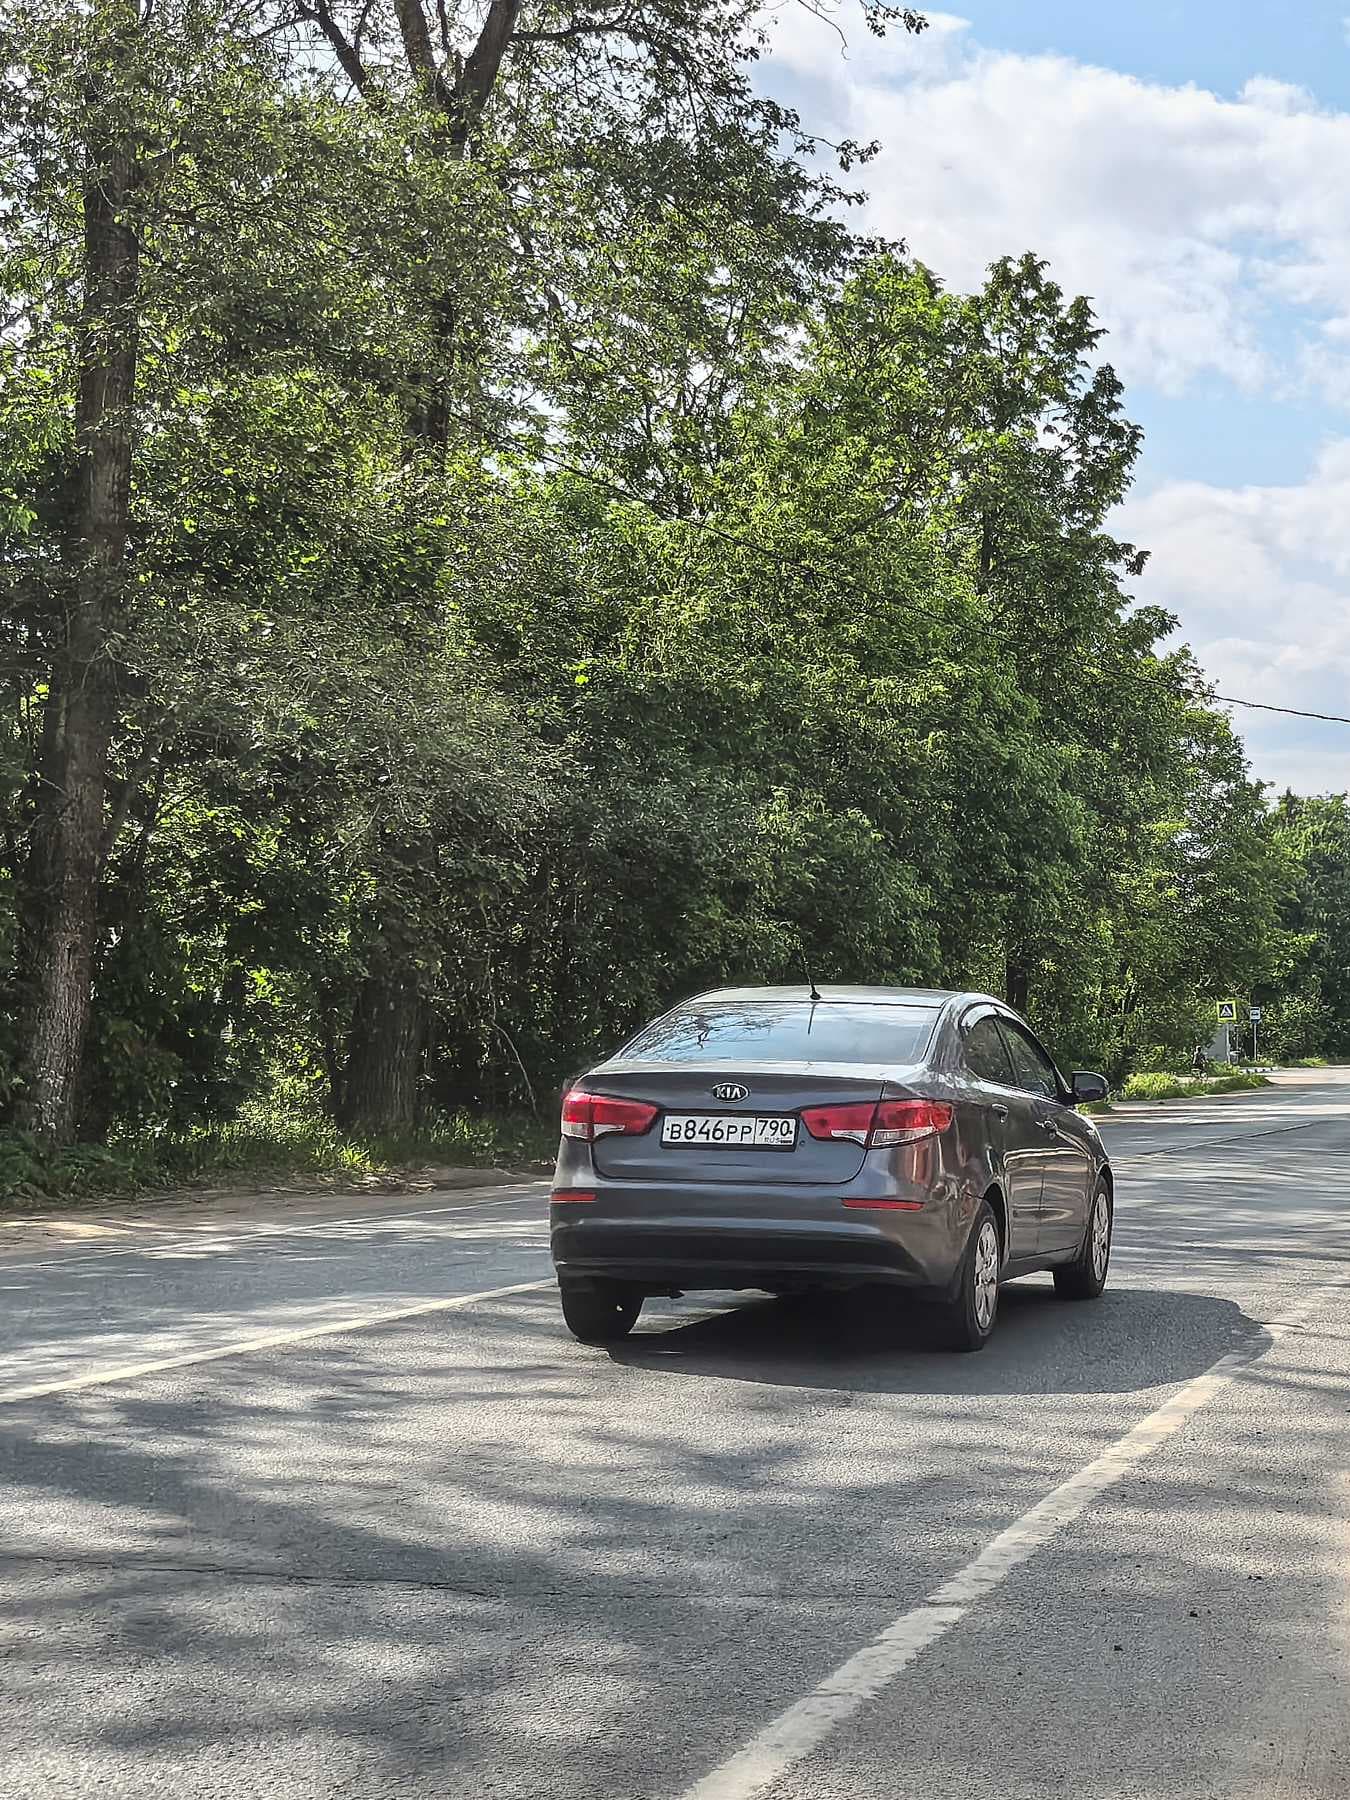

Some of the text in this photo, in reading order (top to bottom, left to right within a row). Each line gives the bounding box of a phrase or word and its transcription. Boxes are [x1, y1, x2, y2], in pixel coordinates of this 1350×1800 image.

[716, 1086, 741, 1098] KIA
[670, 1119, 790, 1141] В846РР 790
